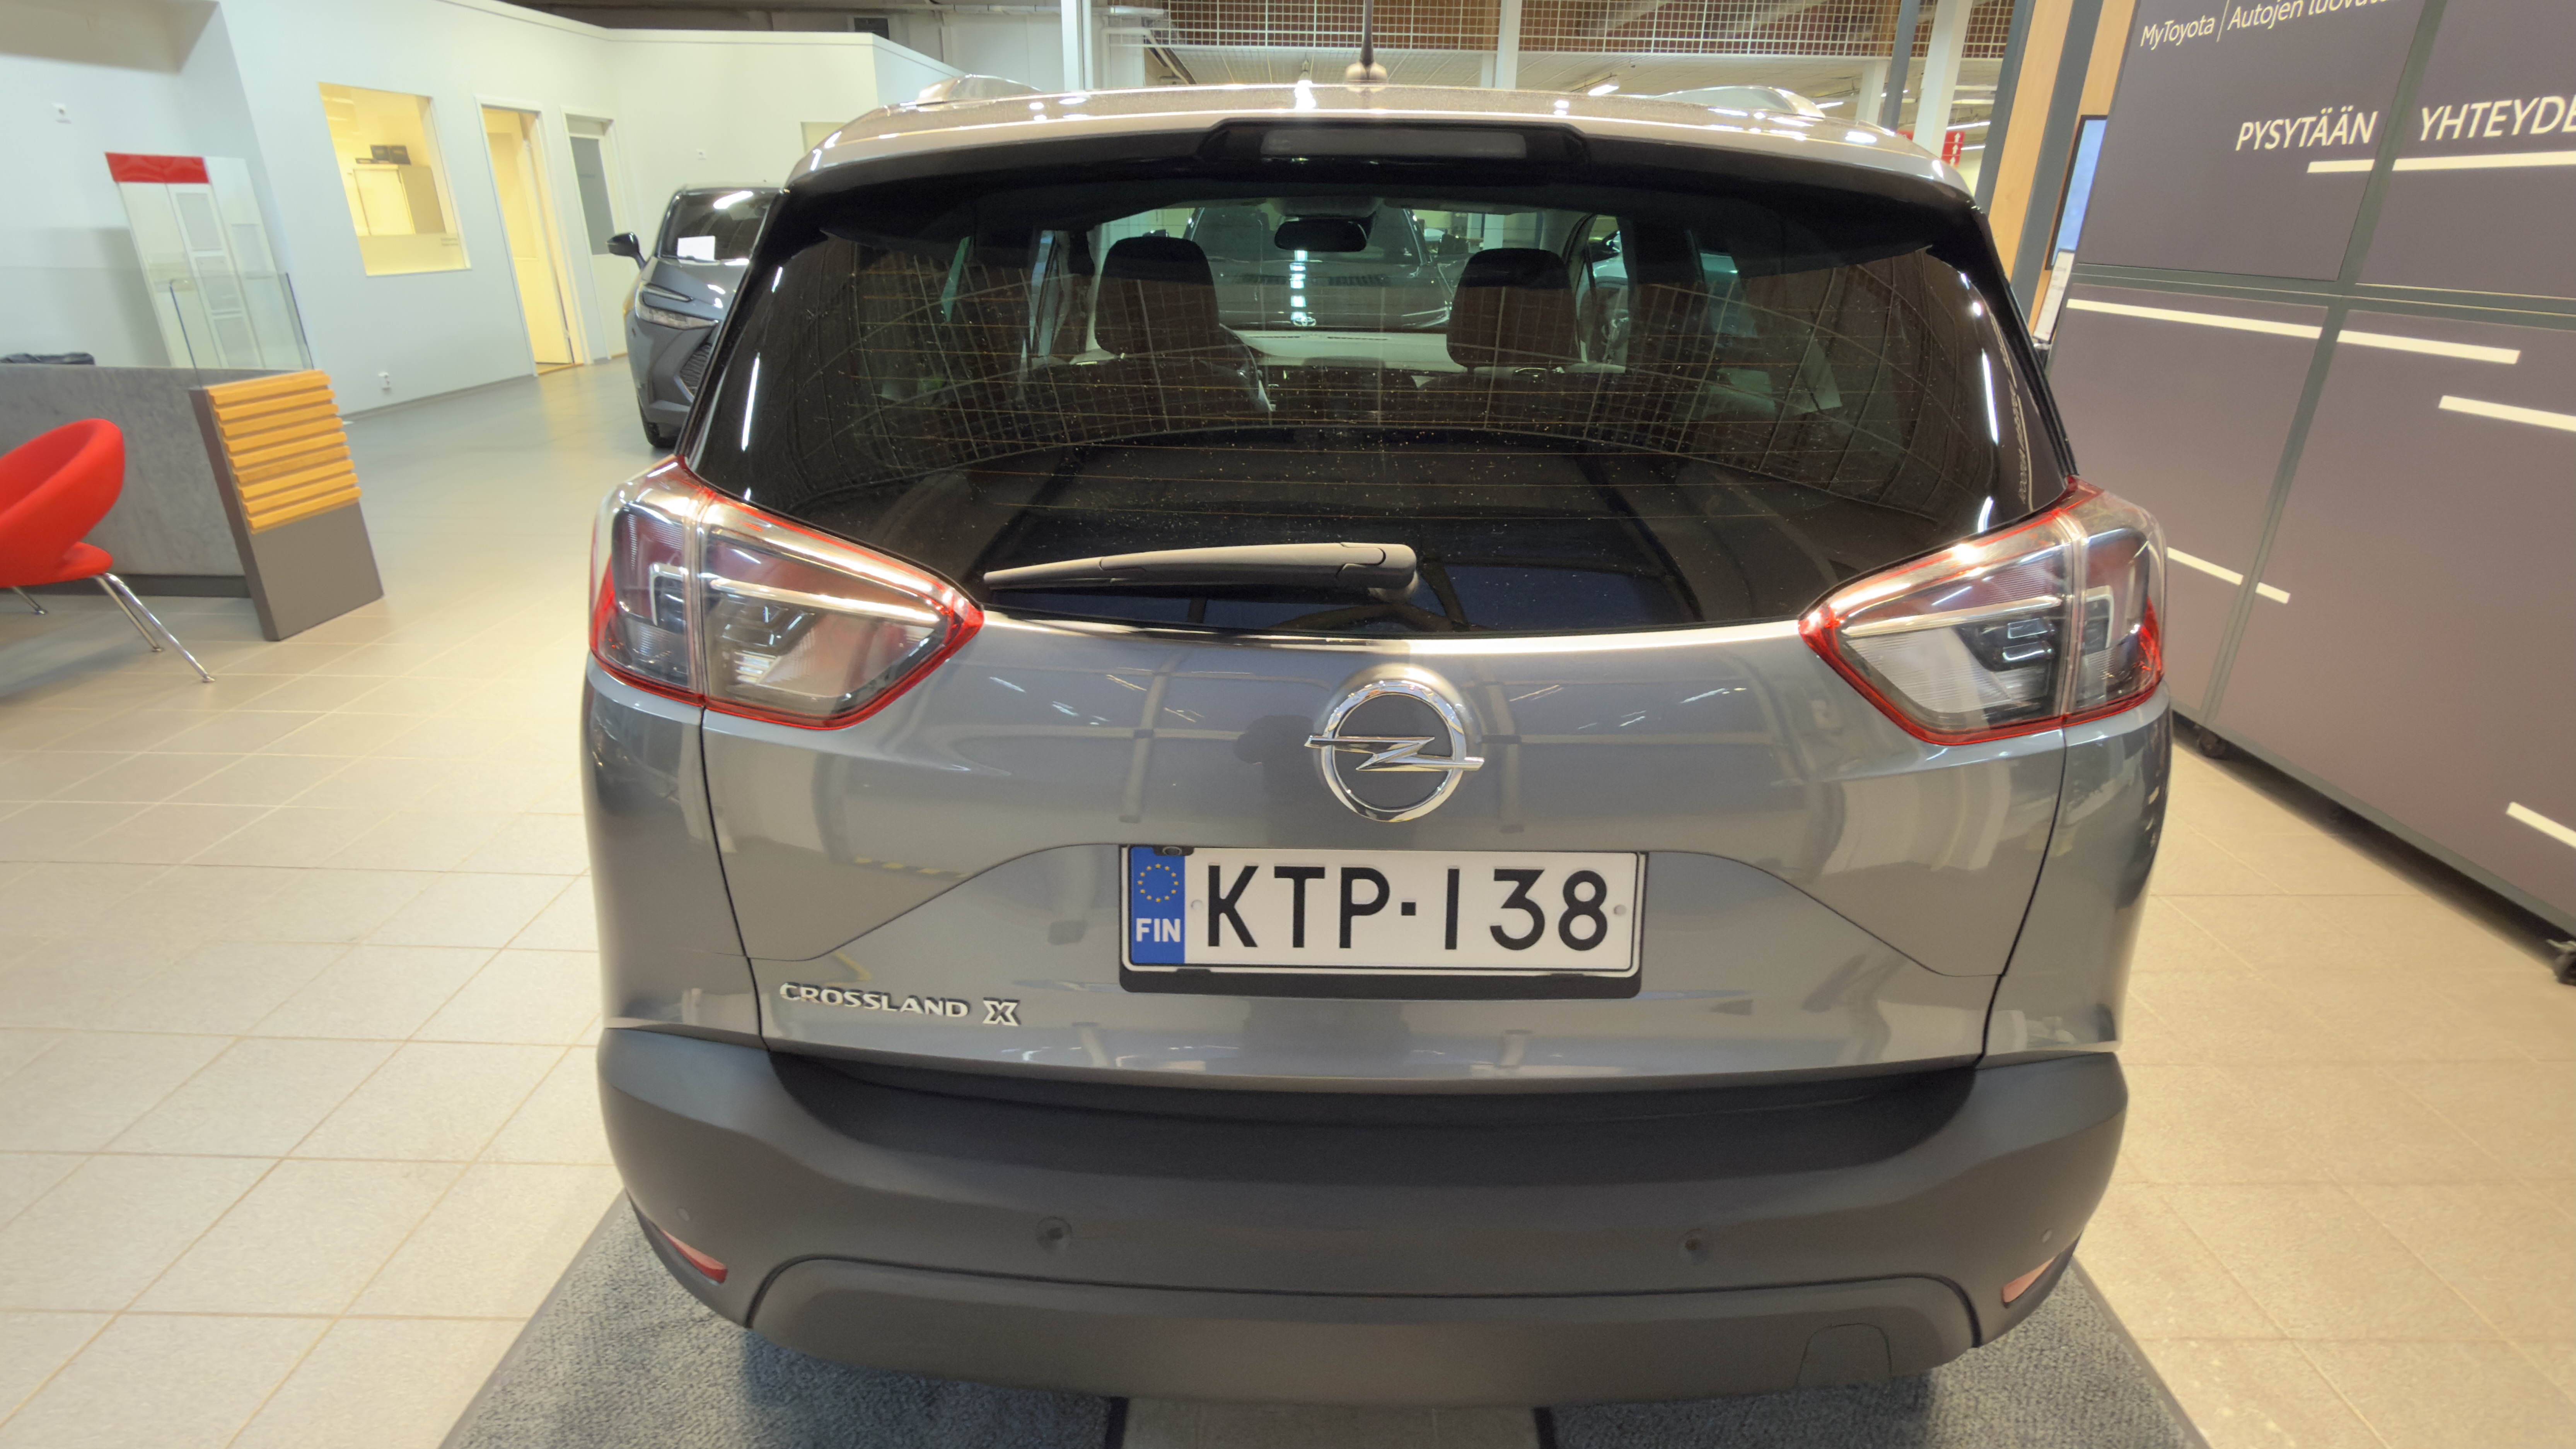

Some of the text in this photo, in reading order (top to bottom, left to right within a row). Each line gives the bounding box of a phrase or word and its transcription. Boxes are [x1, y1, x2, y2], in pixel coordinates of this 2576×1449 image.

[2139, 15, 2216, 51] MyToyota
[2226, 0, 2304, 30] Autojen
[2235, 105, 2379, 151] PYSYTÄÄN
[1136, 918, 1181, 942] FIN
[779, 982, 1020, 1027] CROSSLAND X
